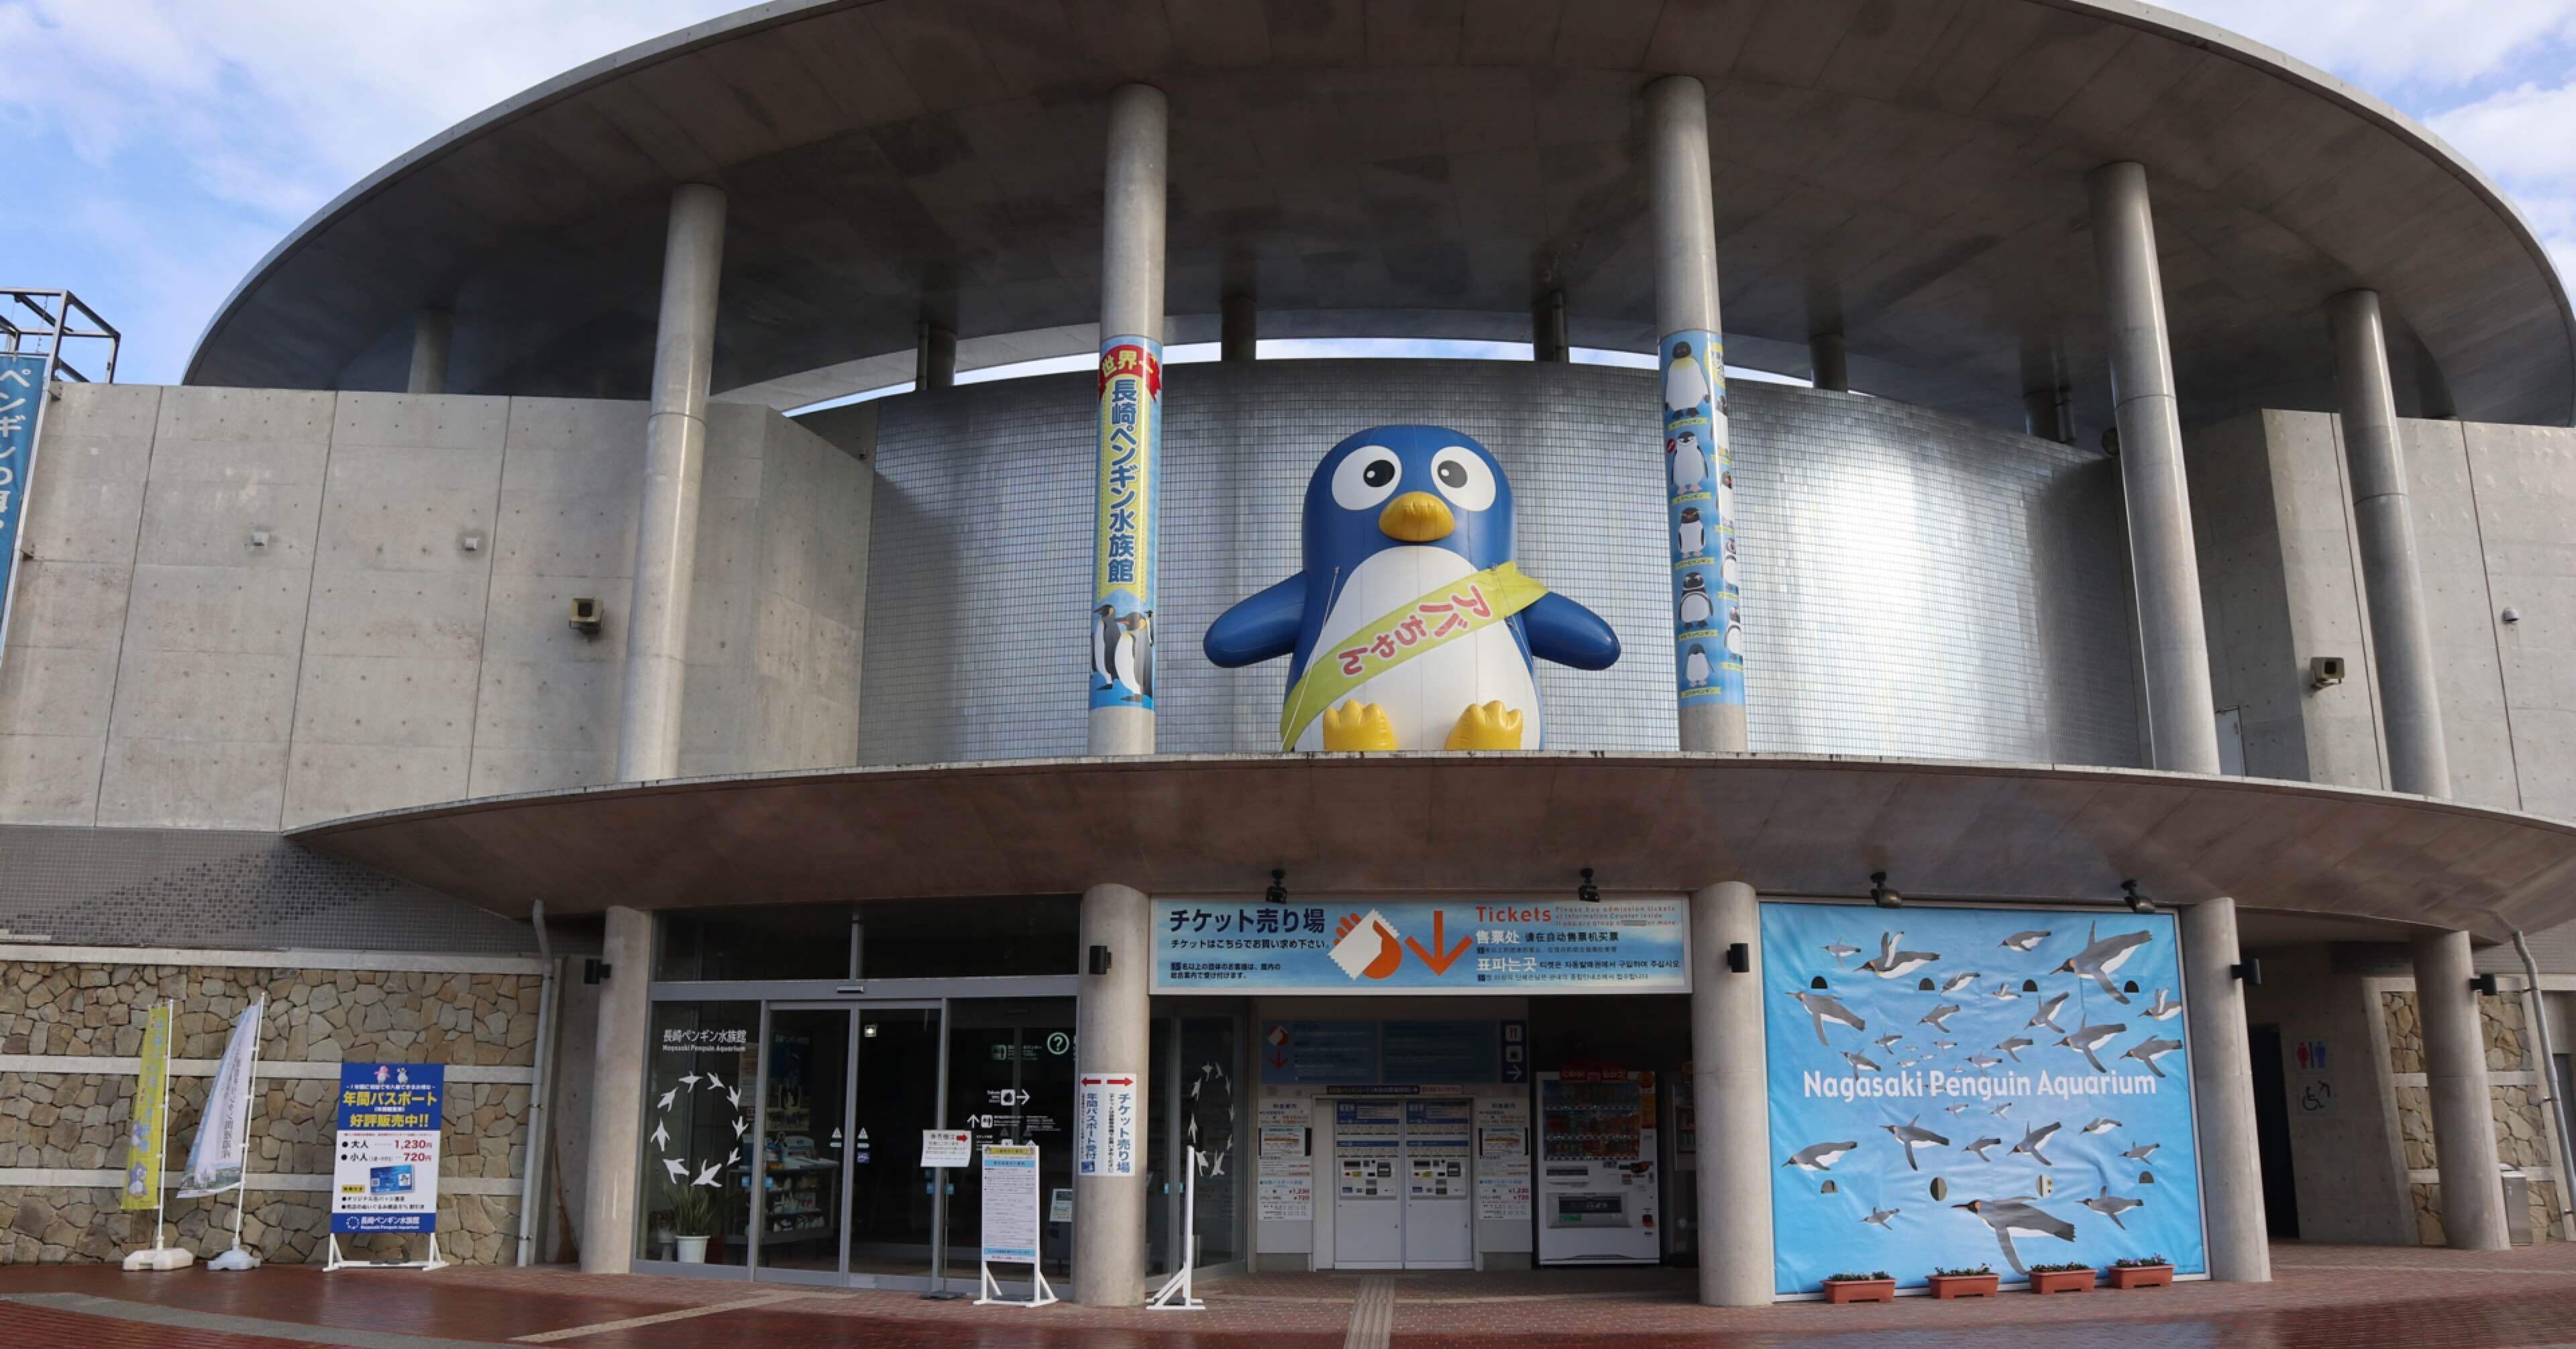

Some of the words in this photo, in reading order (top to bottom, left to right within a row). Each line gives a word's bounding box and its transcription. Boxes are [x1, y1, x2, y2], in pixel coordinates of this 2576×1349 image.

[1102, 349, 1154, 377] 世界一
[1108, 379, 1138, 584] 長崎ペンギン水族館
[1338, 584, 1491, 676] アバちゃん
[1169, 908, 1326, 933] チケット売り場
[1476, 906, 1552, 922] Tickets
[1171, 939, 1330, 949] チケットはこちらでお買い求め下さい。
[1476, 930, 1519, 945] 售票处
[1477, 957, 1537, 972] 표파는곳
[664, 1029, 746, 1042] 長崎ペンギン水族館
[691, 1044, 714, 1053] Penguin
[716, 1044, 746, 1053] Aquarium
[1804, 1071, 1923, 1102] Nagasaki
[1930, 1071, 2030, 1101] Penguin
[2037, 1071, 2157, 1101] Aquarium
[343, 1090, 437, 1106] 年間パスポート
[350, 1114, 429, 1128] 好評販売中!!
[1085, 1093, 1098, 1160] 年間パスポート受付
[1116, 1093, 1131, 1173] チケット売り場
[351, 1140, 369, 1149] 大人
[394, 1140, 433, 1149] 1,230円
[350, 1153, 368, 1162] 小人
[404, 1152, 431, 1162] 720円
